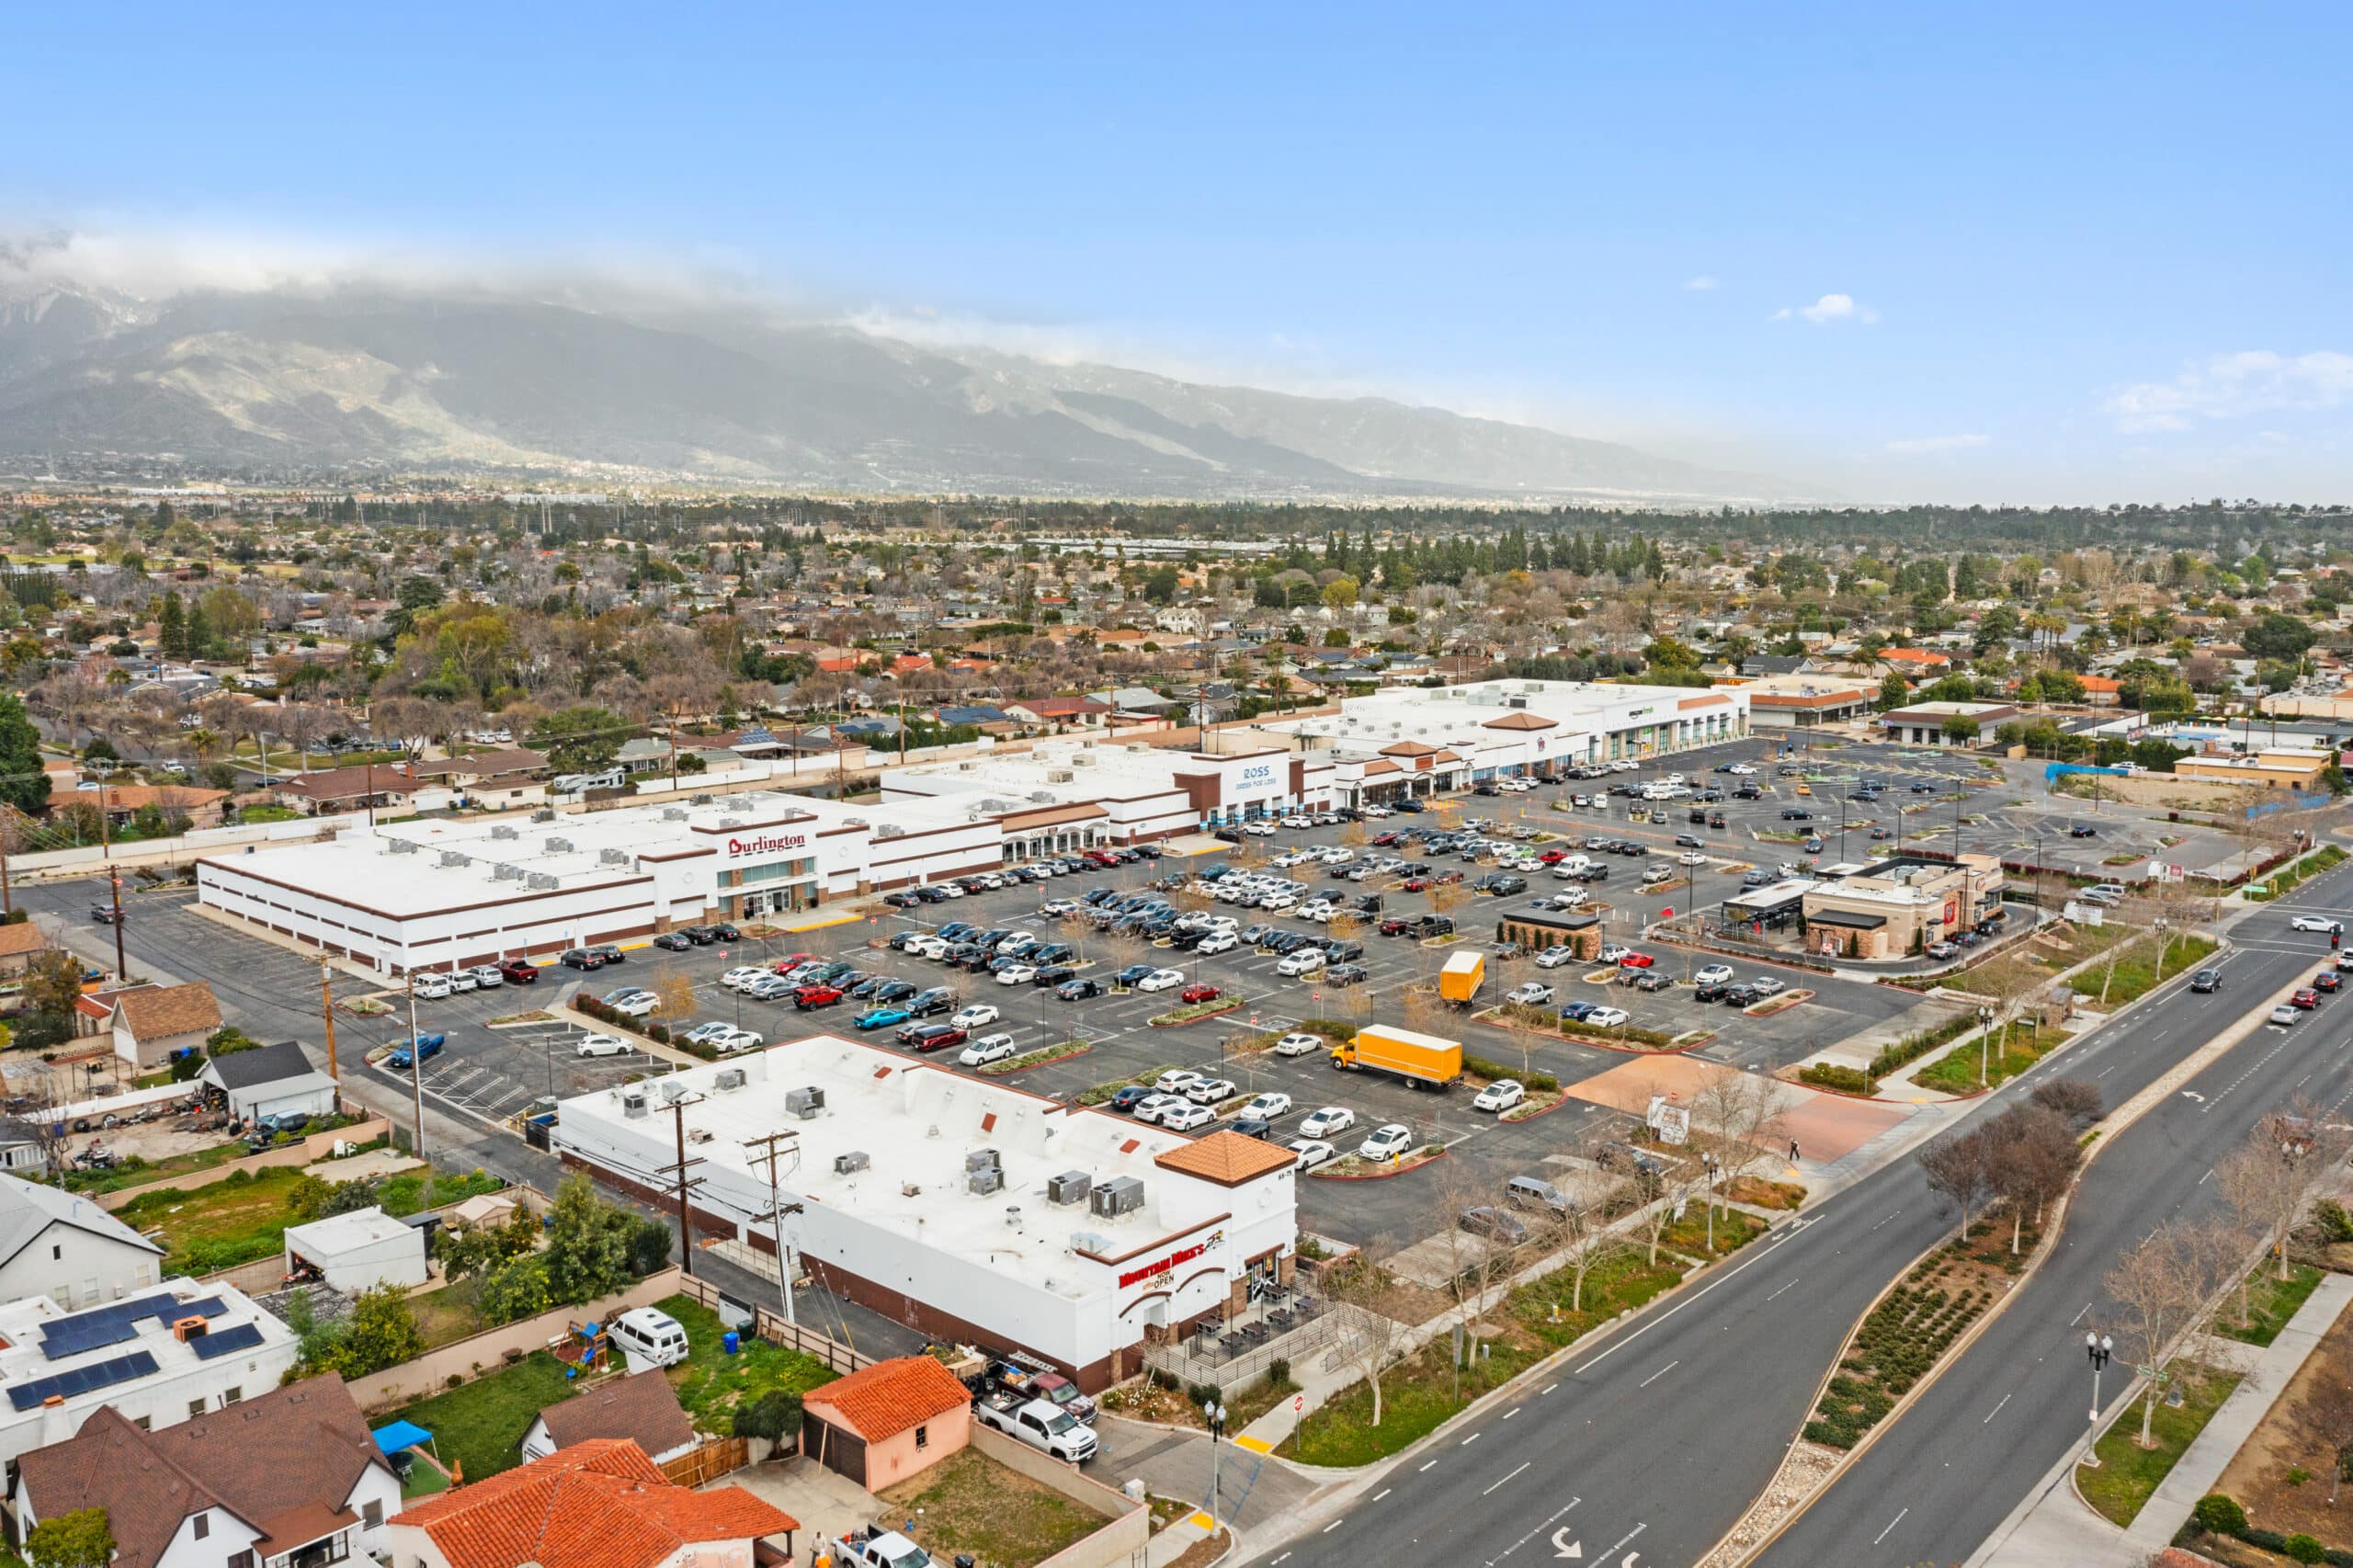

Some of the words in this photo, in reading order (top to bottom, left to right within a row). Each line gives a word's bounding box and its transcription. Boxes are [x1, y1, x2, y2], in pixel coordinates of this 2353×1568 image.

[1244, 766, 1269, 779] ROSS
[729, 835, 805, 853] Burlington
[1119, 1257, 1171, 1289] MOUNTAIN
[1157, 1270, 1170, 1279] NOW
[1154, 1274, 1174, 1288] OPEN
